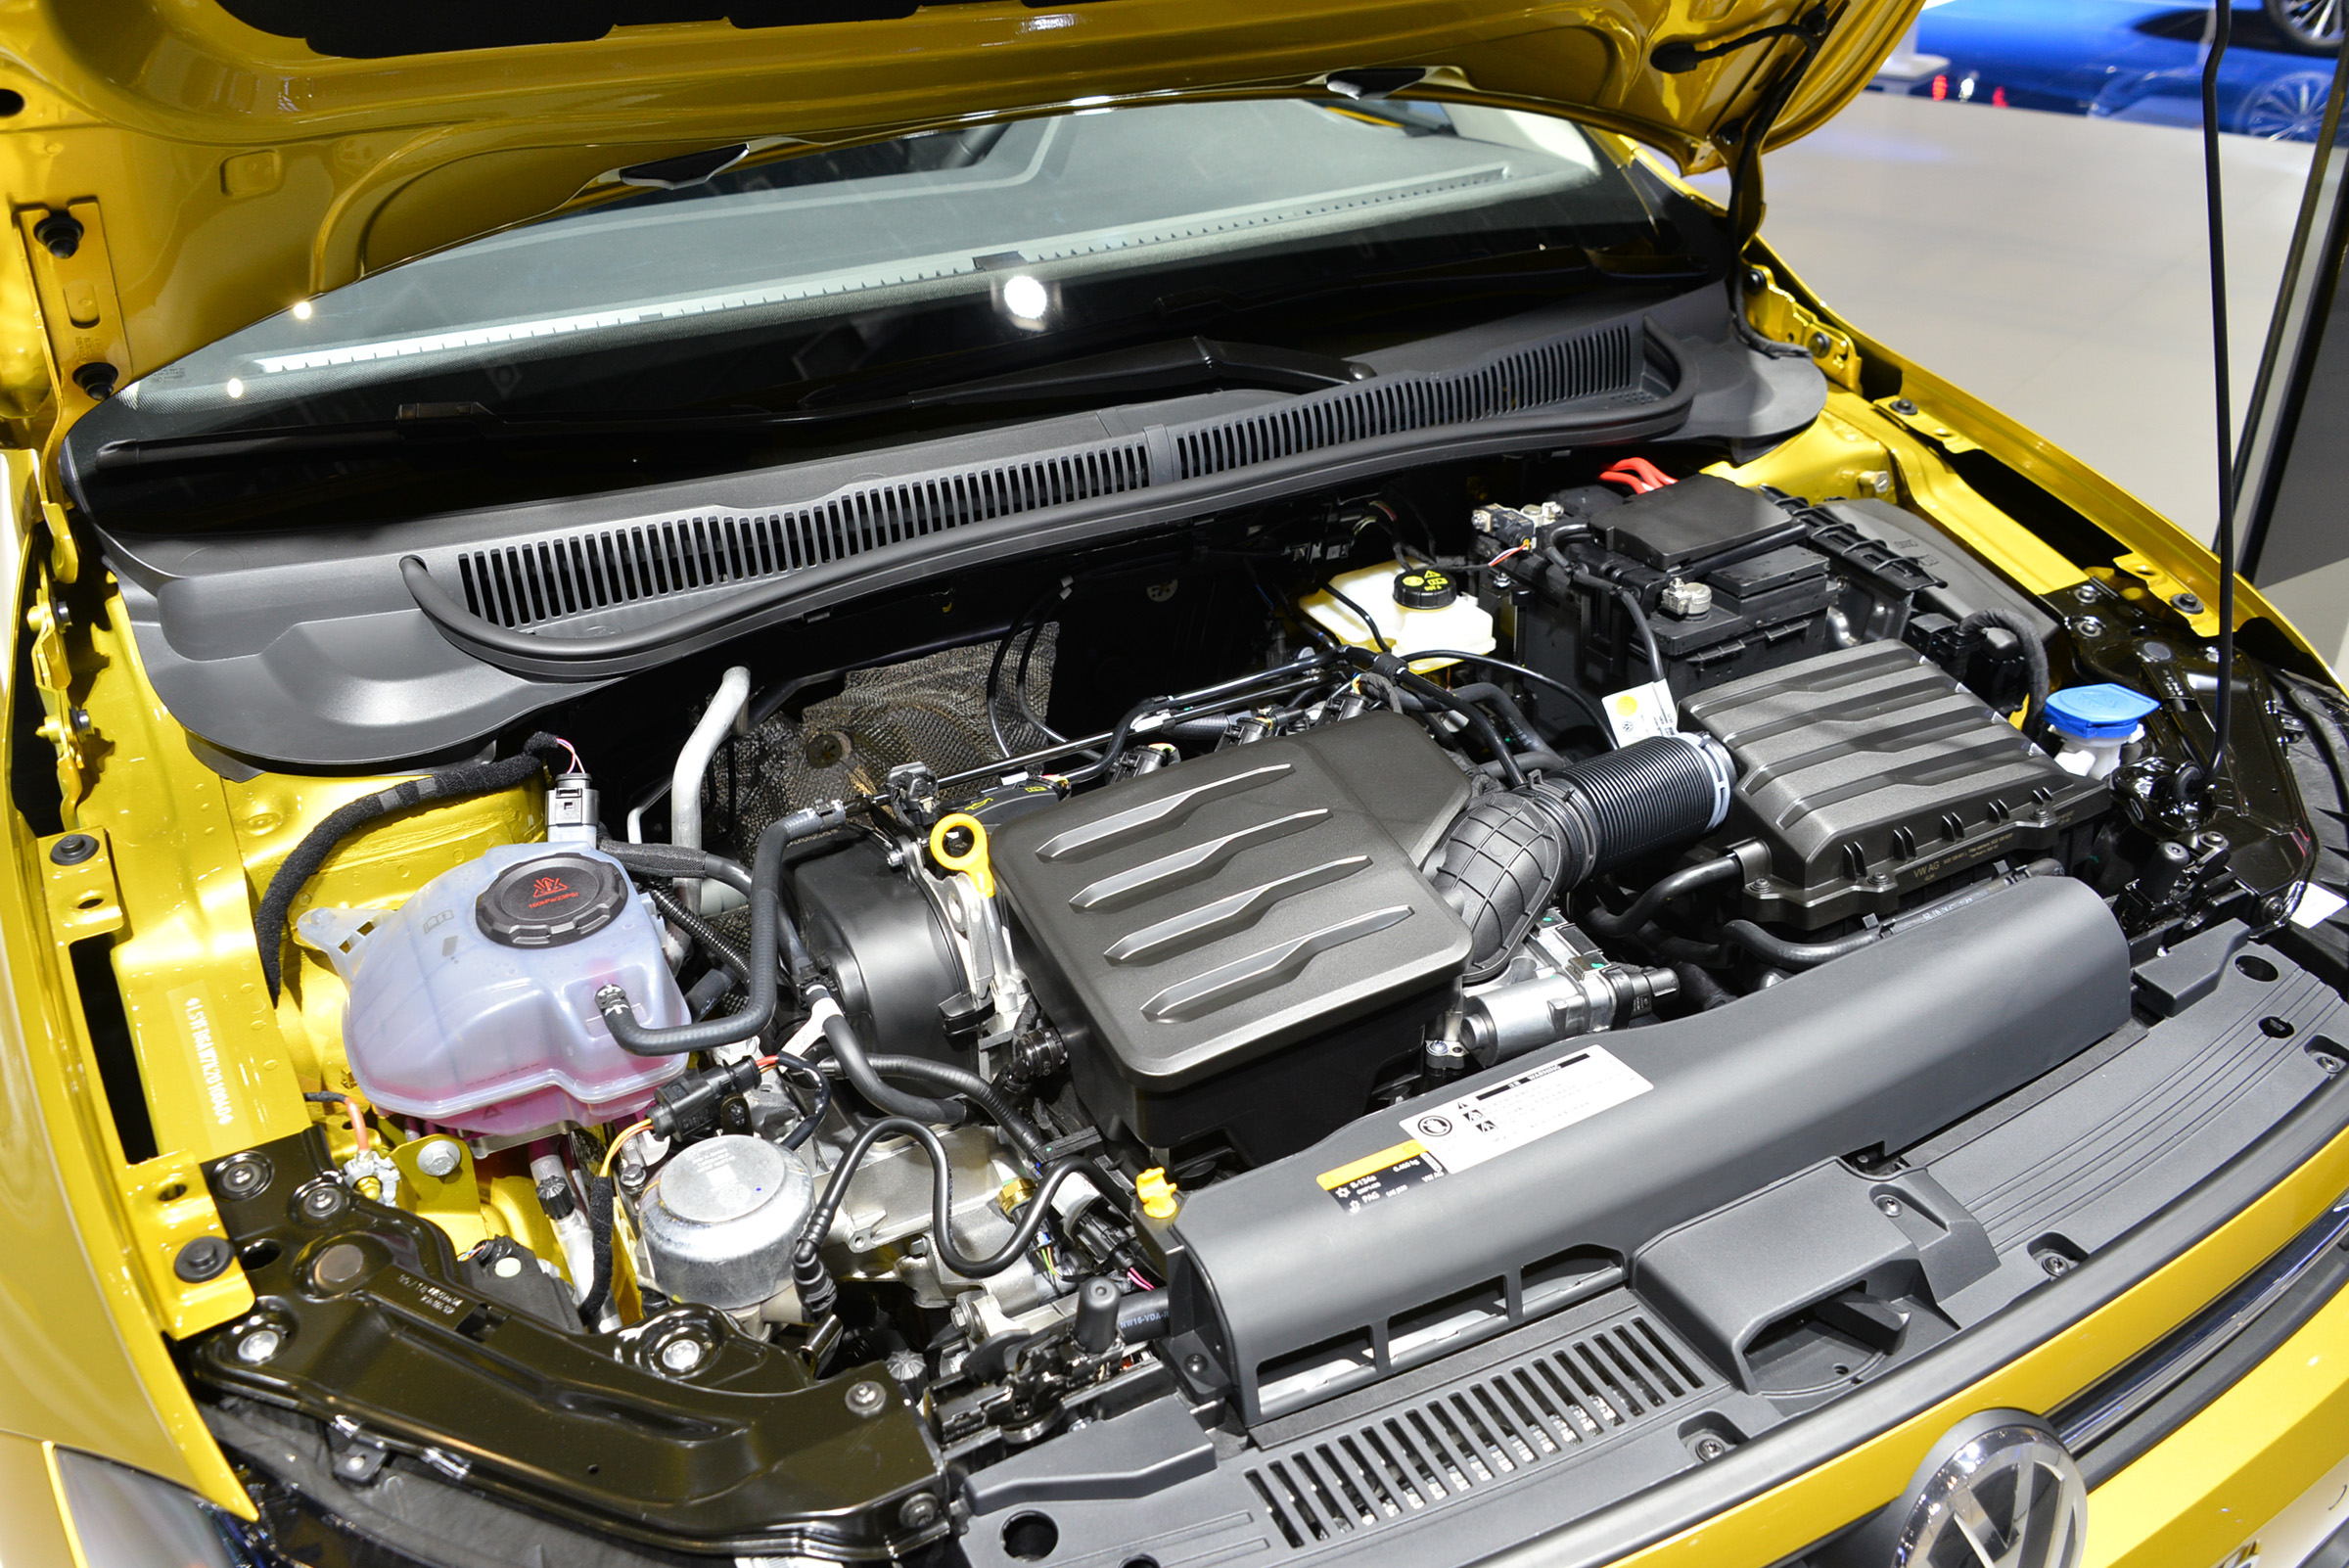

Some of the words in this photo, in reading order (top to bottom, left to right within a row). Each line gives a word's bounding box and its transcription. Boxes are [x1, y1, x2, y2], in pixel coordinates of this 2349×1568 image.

[1913, 866, 1927, 878] VW
[1927, 860, 1941, 873] AG
[1361, 1191, 1380, 1203] PAG
